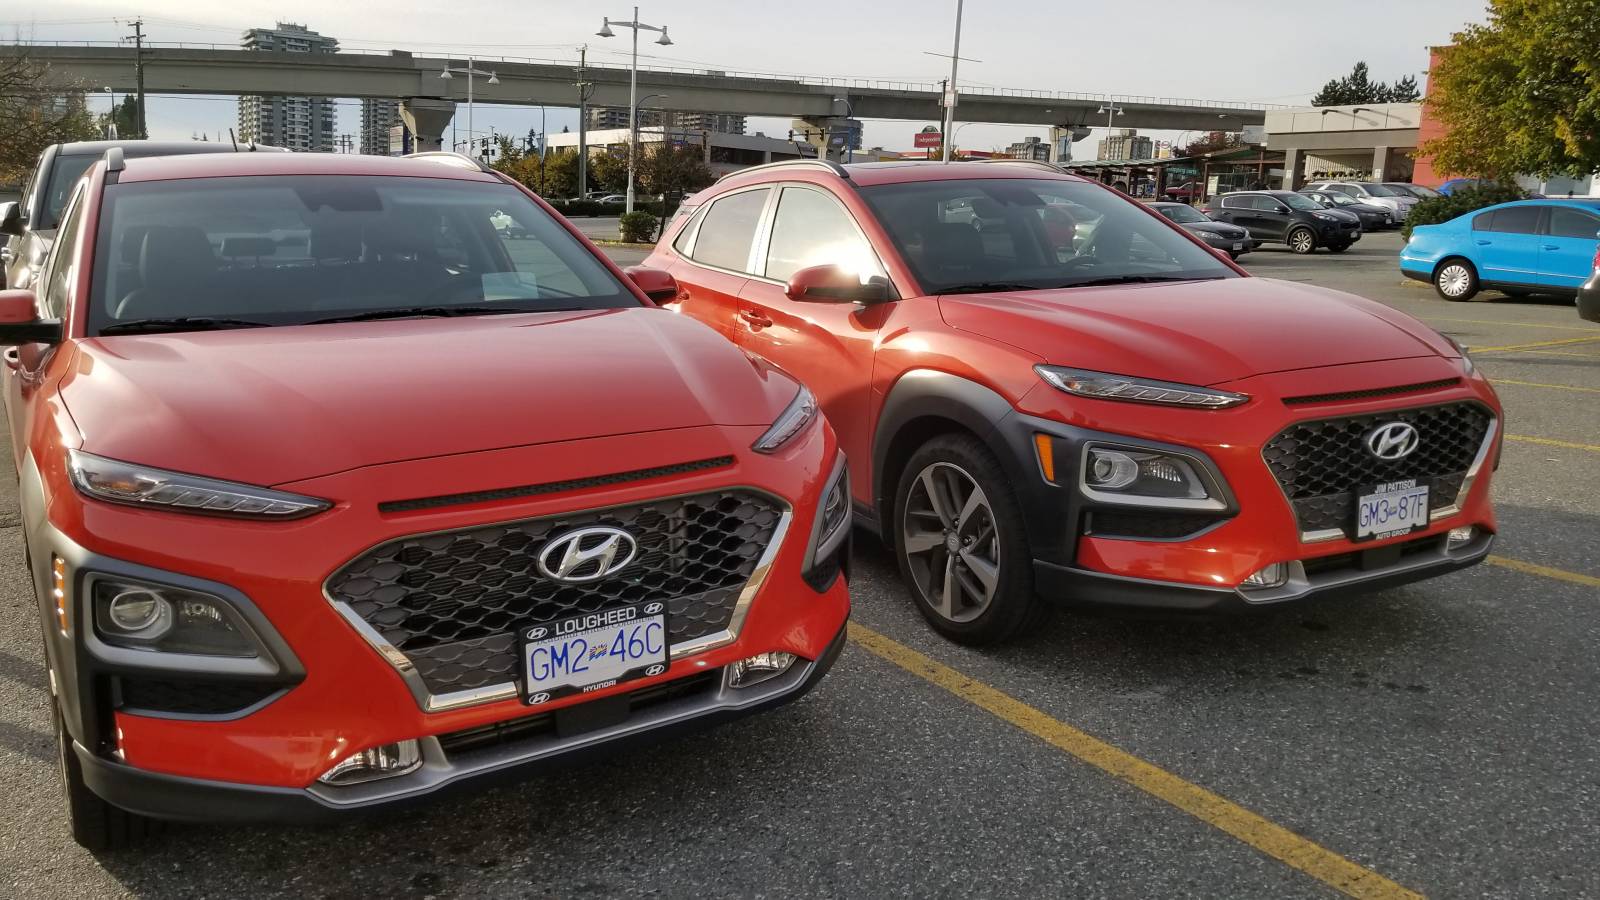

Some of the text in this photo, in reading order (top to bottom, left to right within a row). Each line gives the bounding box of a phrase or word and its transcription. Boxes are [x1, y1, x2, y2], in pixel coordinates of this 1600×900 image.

[1375, 483, 1387, 494] JIM
[1387, 479, 1416, 492] PATTISON
[1360, 500, 1389, 527] GM3
[1398, 493, 1427, 520] 87F
[1376, 531, 1391, 540] AUTO
[556, 607, 636, 635] LOUGHEED
[531, 639, 589, 681] GM2
[609, 622, 663, 662] 46C
[583, 680, 617, 693] HYUNDAI
